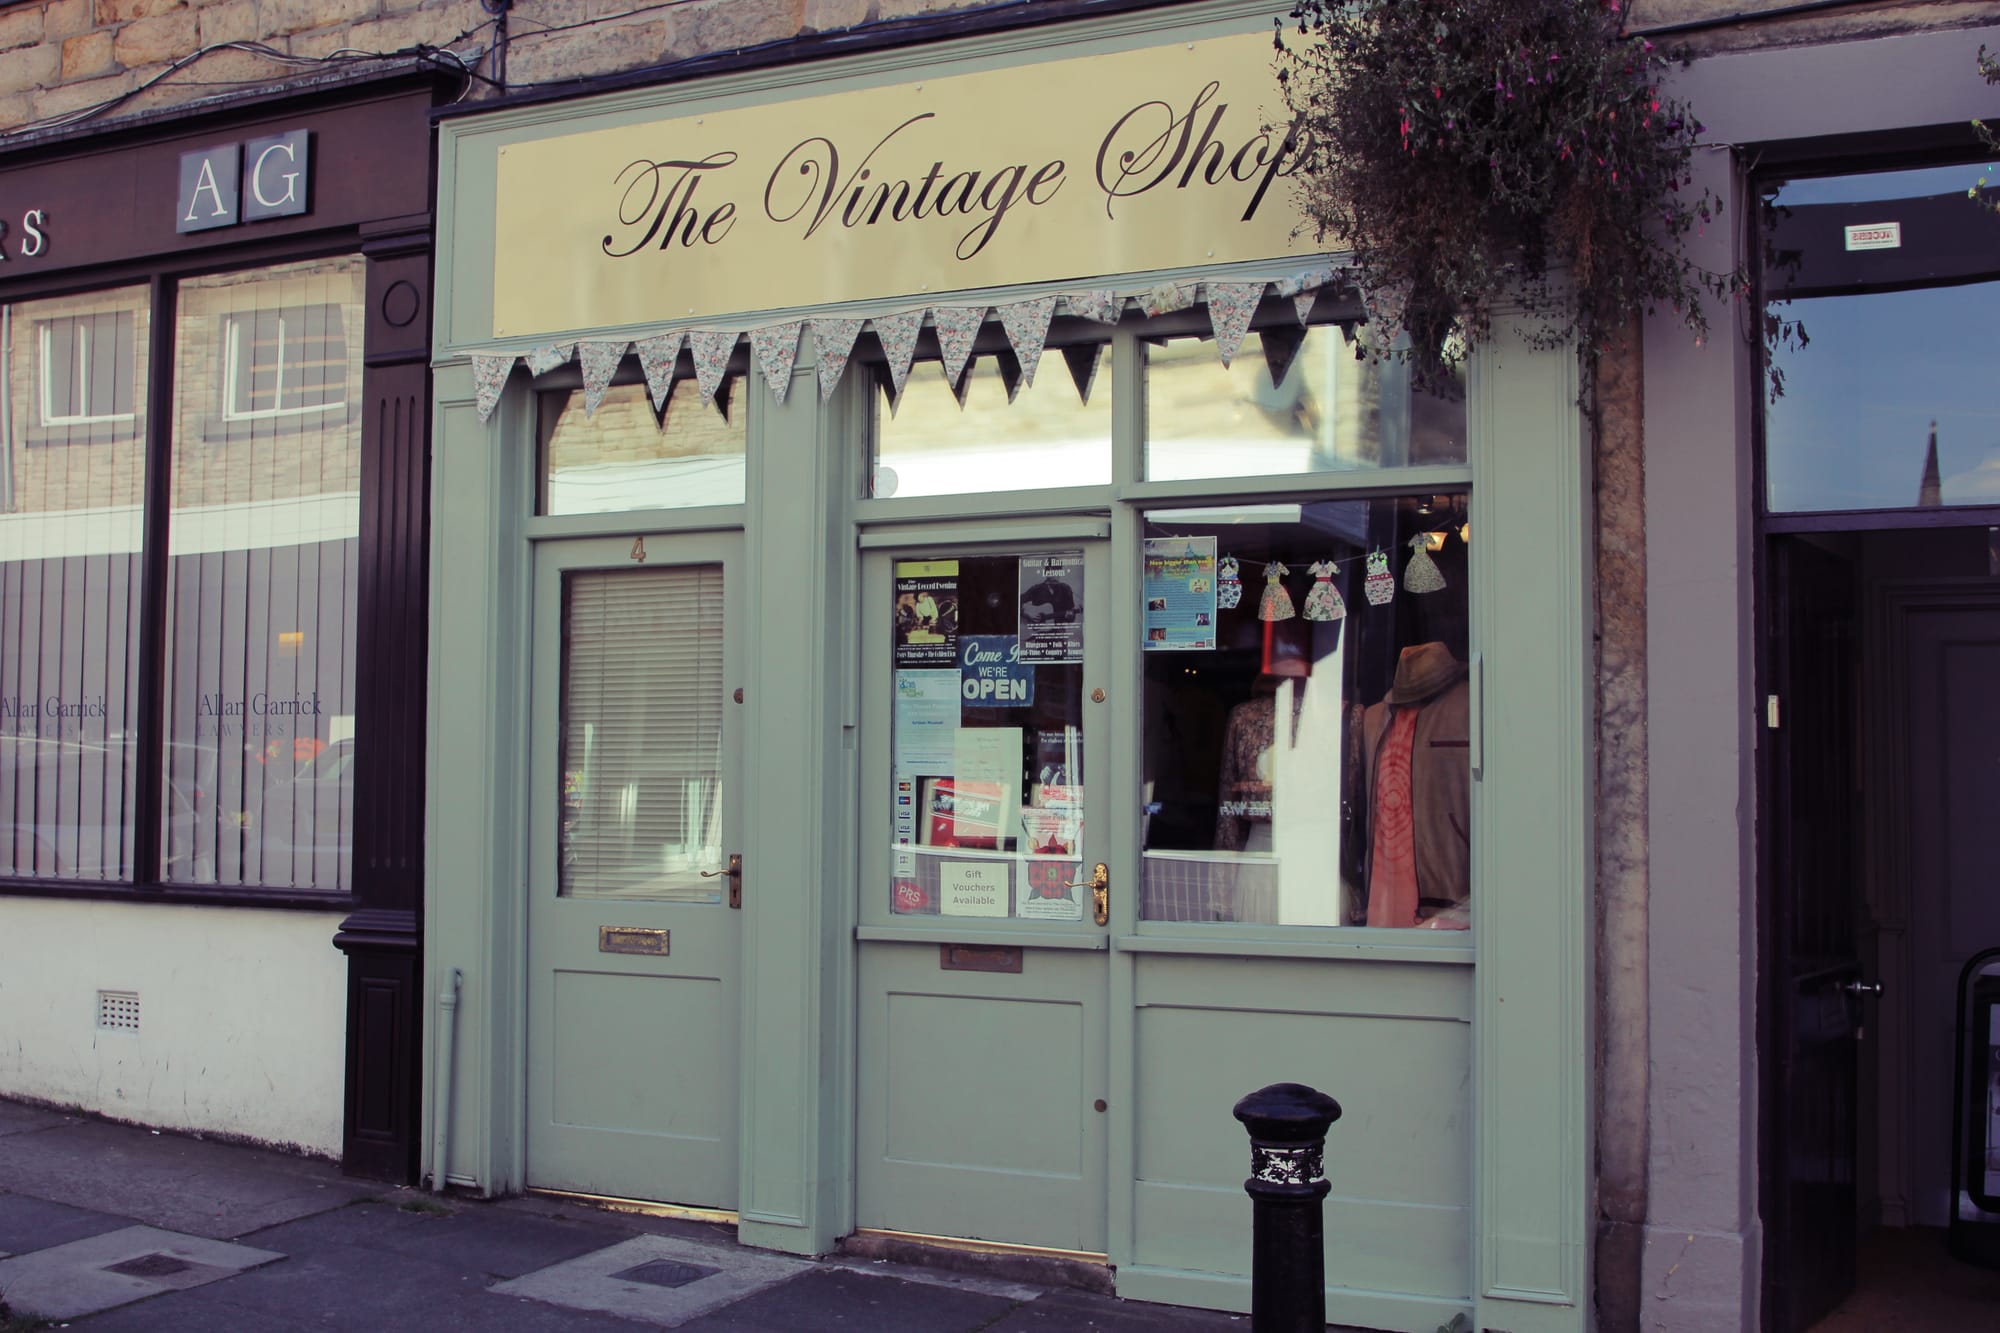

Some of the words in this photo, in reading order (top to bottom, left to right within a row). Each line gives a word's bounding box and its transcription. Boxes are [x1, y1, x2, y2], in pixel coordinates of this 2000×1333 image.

[602, 151, 738, 257] The
[764, 112, 1066, 261] Vintage
[1095, 80, 1316, 222] Shop
[630, 536, 647, 563] 4
[964, 641, 1003, 666] Come
[1005, 644, 1018, 663] I
[978, 666, 1008, 678] WE'RE
[962, 678, 1027, 700] OPEN
[252, 692, 322, 716] Garrick
[965, 870, 982, 879] Gift
[898, 885, 921, 903] PRS
[952, 883, 996, 892] Vouchers
[952, 896, 996, 905] Available
